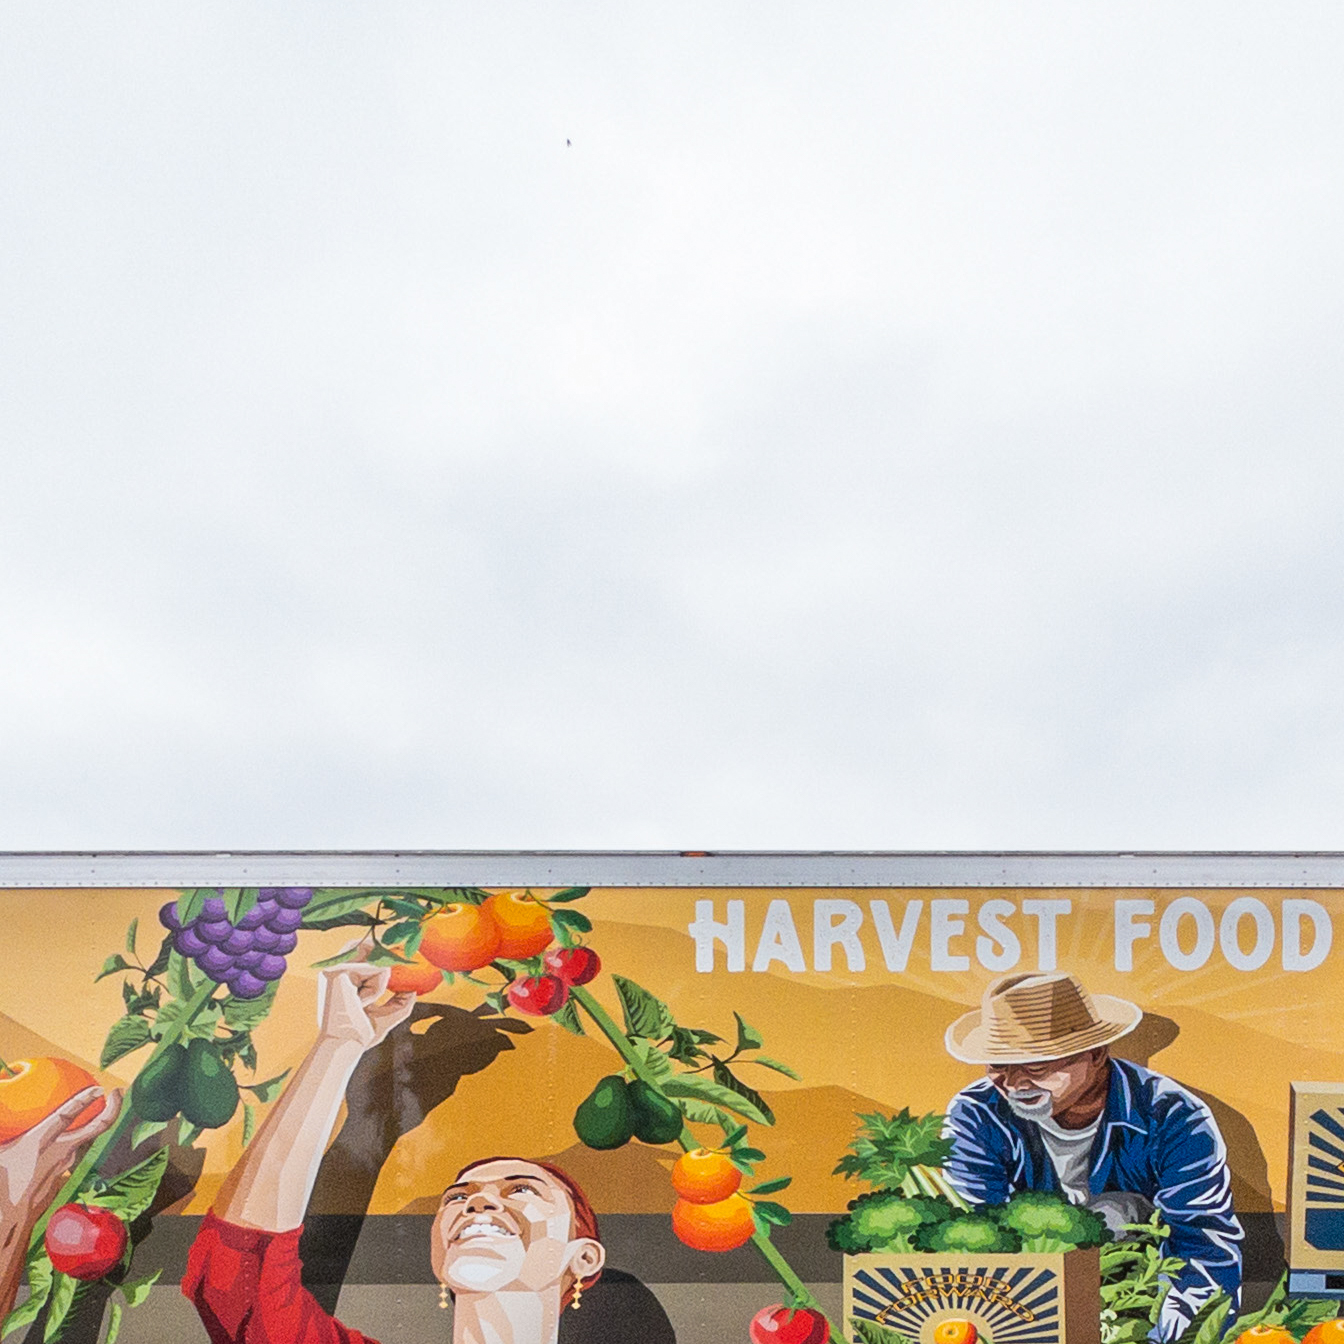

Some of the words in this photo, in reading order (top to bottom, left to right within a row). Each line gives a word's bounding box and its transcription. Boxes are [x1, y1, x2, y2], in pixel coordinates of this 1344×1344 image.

[688, 899, 1072, 973] HARVEST
[1114, 896, 1333, 973] FOOD
[901, 1273, 1012, 1294] FOOD
[875, 1286, 1035, 1325] FORWARD
